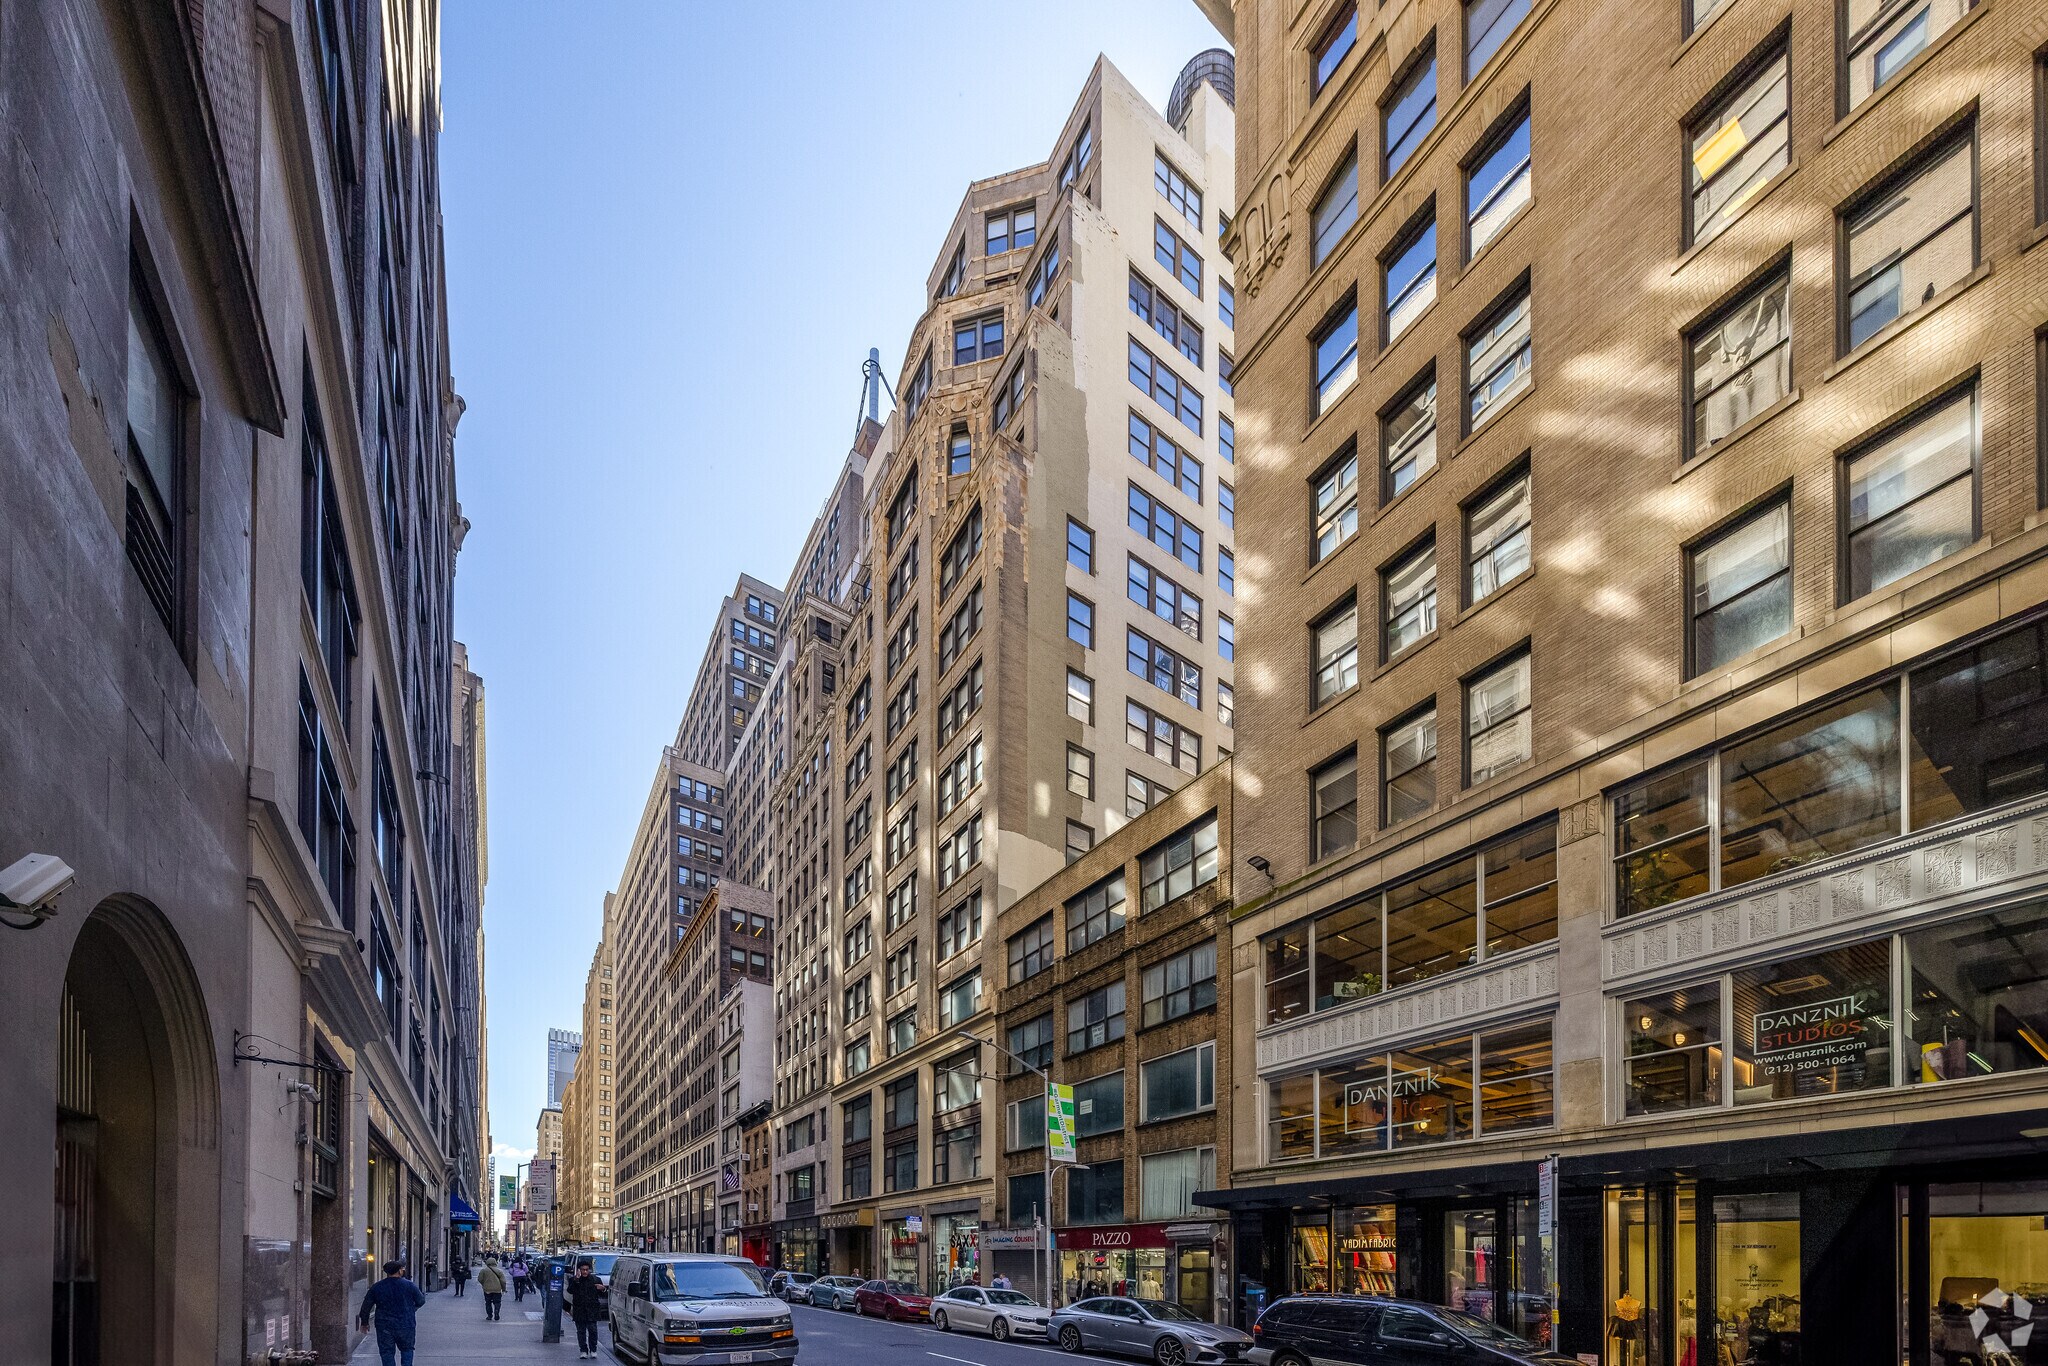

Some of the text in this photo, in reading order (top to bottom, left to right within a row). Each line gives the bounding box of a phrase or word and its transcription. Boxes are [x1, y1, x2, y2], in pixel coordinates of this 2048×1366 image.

[1760, 999, 1866, 1031] DANZNIK
[1762, 1020, 1863, 1049] STUDIOS
[1754, 1041, 1867, 1065] www.danznik.com
[1764, 1054, 1856, 1076] (212) 500-1064
[1350, 1073, 1441, 1105] DANZNIK
[1092, 1231, 1131, 1246] PAZZO
[1343, 1238, 1368, 1249] VADIM
[555, 1266, 562, 1275] P
